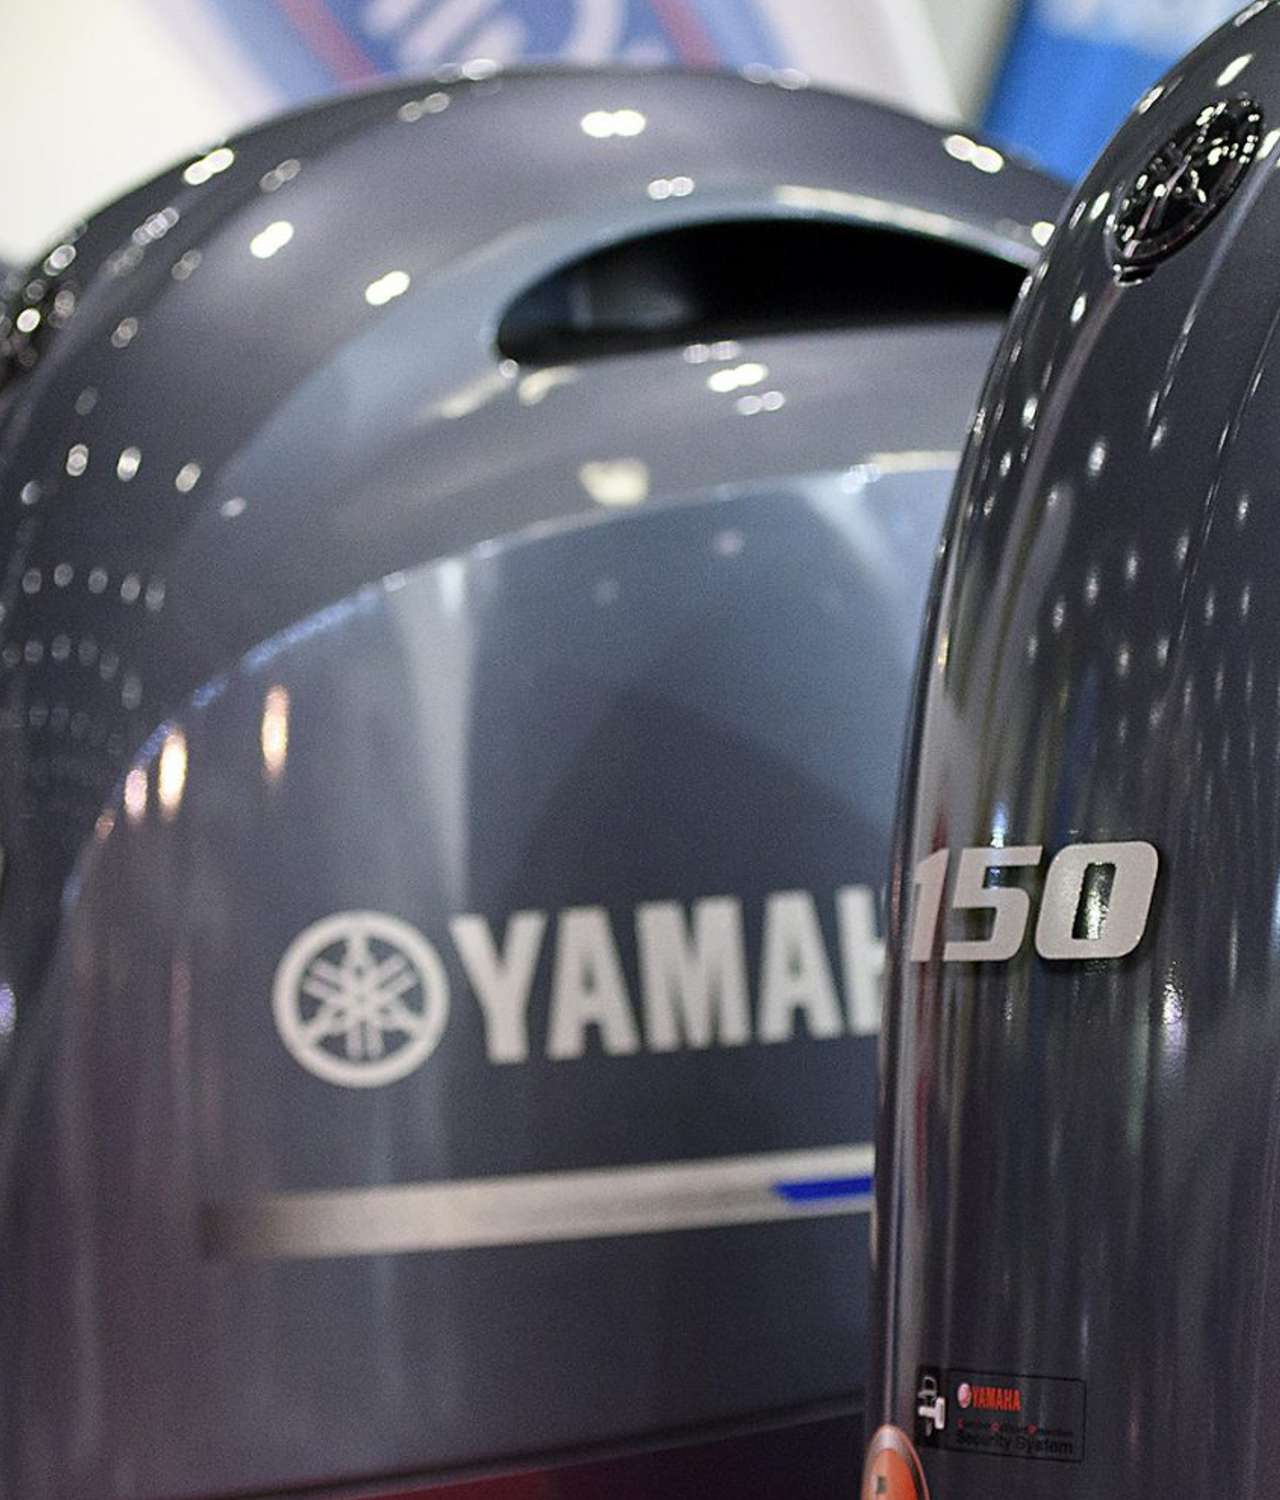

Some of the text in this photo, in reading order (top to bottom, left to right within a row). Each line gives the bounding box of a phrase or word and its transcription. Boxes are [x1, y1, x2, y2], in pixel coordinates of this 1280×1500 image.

[910, 841, 1159, 961] 150
[972, 1386, 1022, 1412] YAMAHA
[1014, 1436, 1073, 1456] System
